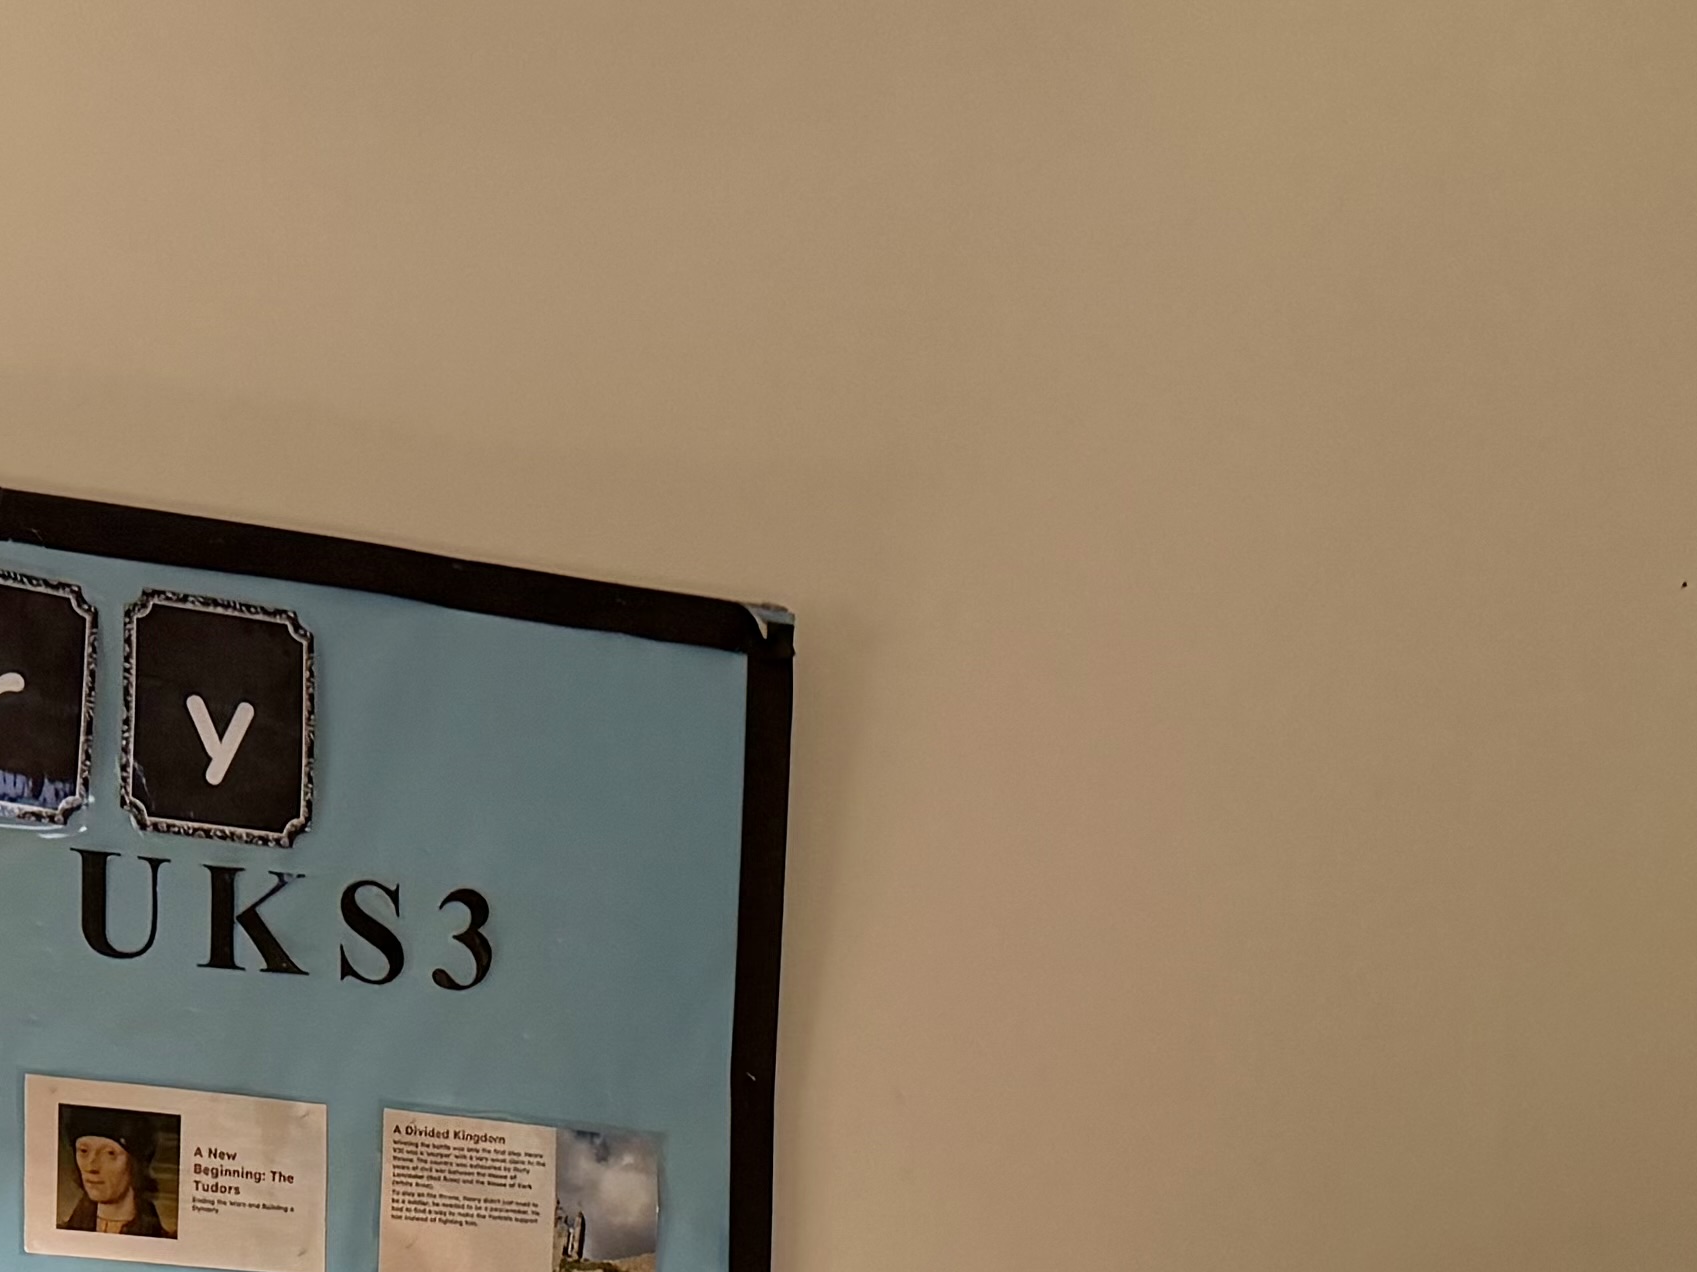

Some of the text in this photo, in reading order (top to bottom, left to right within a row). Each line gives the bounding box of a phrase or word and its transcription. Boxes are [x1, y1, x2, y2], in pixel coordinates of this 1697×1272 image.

[70, 848, 493, 992] UKS3
[393, 1125, 506, 1144] A Divided Kingdom
[193, 1147, 237, 1161] A New
[193, 1163, 294, 1184] Beginning: The
[193, 1180, 240, 1195] Tudors
